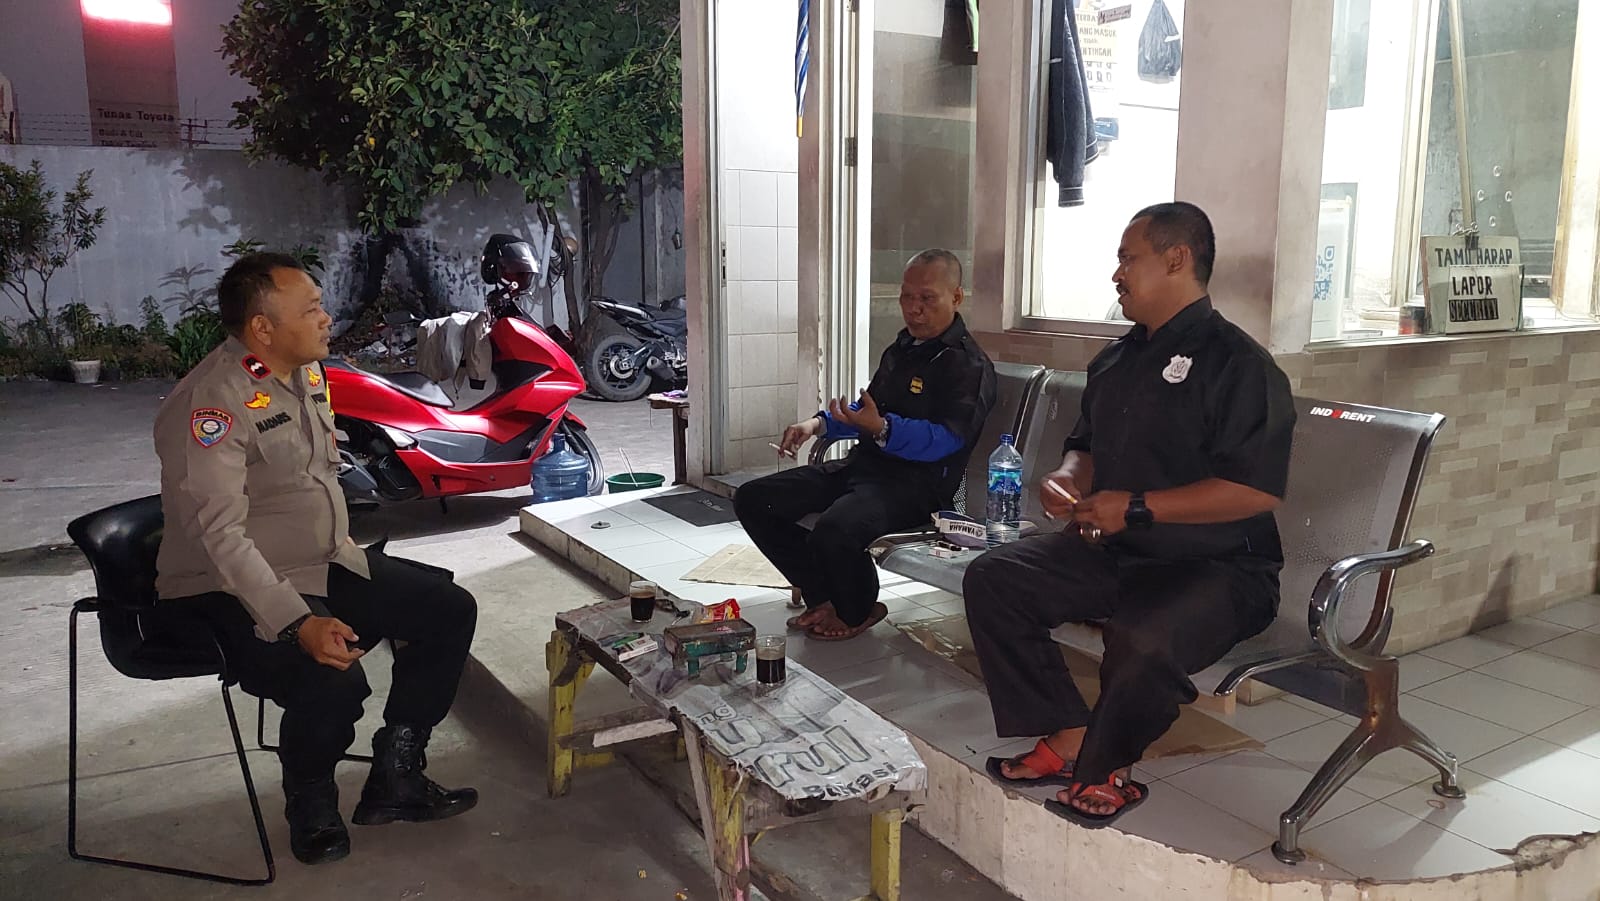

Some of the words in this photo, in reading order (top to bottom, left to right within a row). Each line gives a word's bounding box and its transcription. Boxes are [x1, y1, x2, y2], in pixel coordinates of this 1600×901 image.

[136, 110, 174, 122] Toyota
[1476, 247, 1513, 266] HARAP
[1452, 276, 1493, 296] LAPOR
[1449, 299, 1498, 322] SECURITY
[949, 524, 975, 536] YAMAHA
